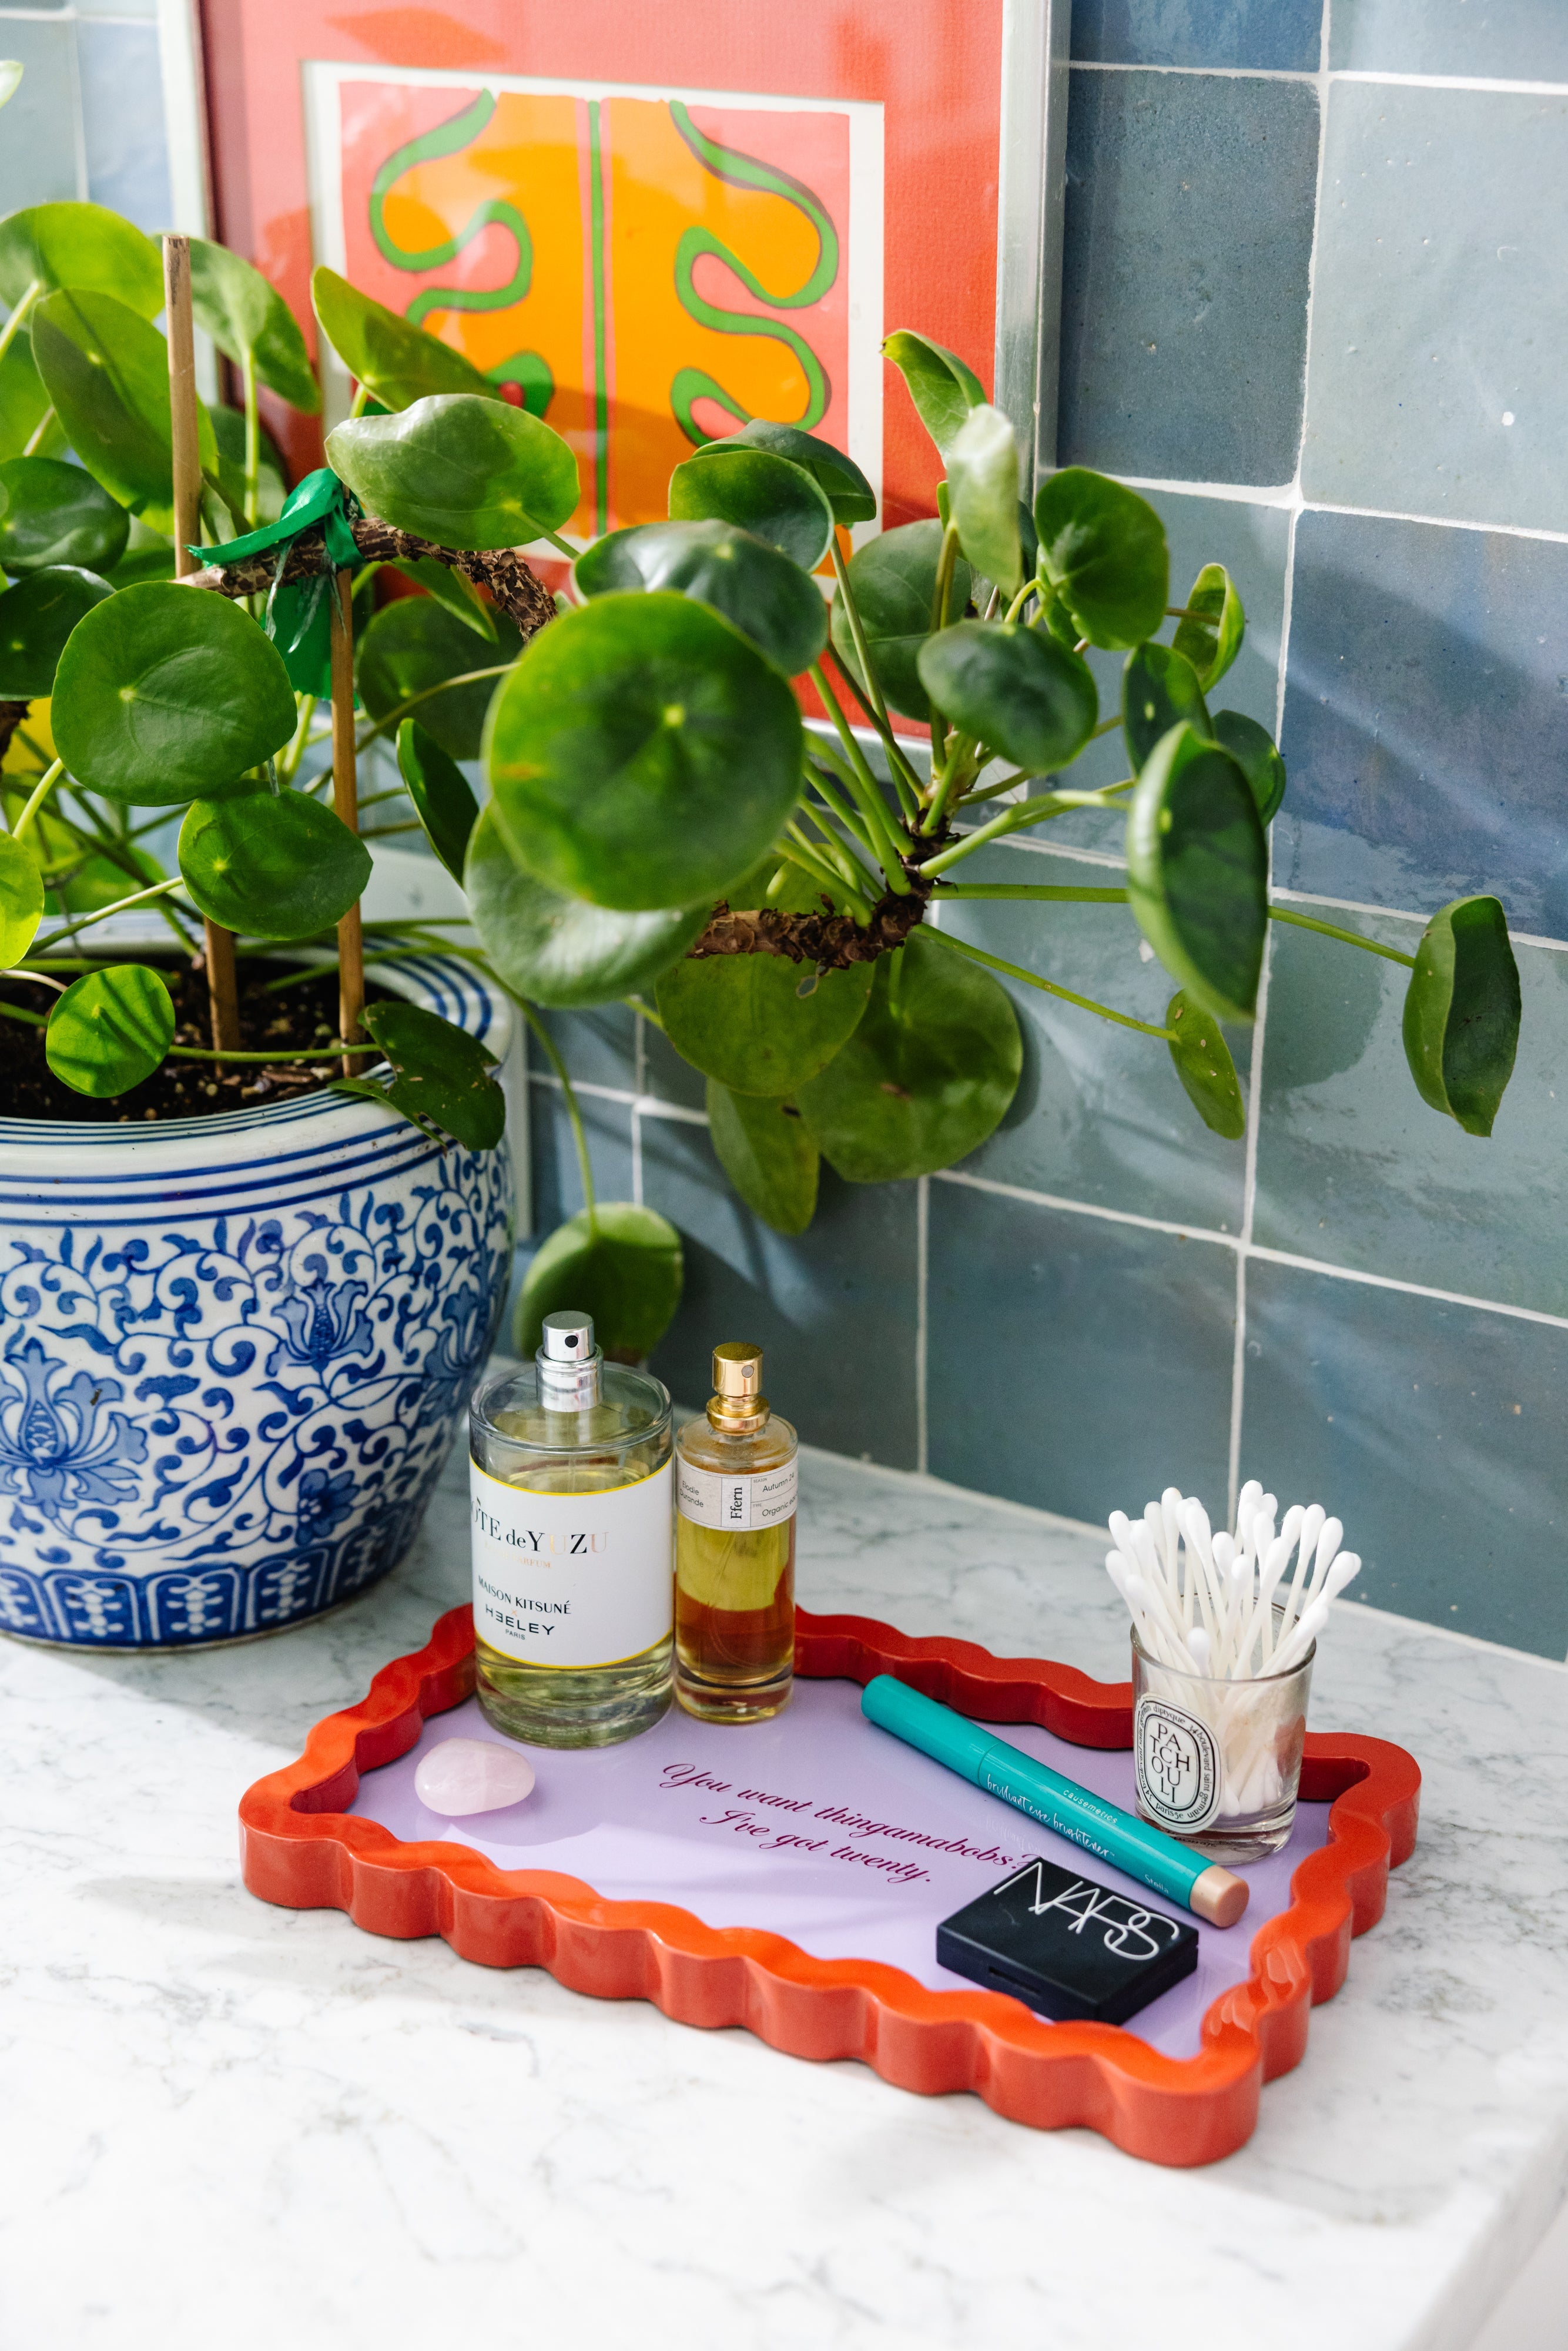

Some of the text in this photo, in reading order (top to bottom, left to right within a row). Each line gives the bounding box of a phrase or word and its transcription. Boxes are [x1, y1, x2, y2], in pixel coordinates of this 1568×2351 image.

[682, 1480, 699, 1495] Elodie
[762, 1478, 788, 1492] Autumn
[679, 1488, 704, 1508] Durande
[730, 1486, 743, 1519] Ffern
[762, 1501, 789, 1516] Organic
[505, 1528, 526, 1548] de
[525, 1530, 609, 1555] YUZU
[512, 1553, 551, 1569] ARFUM
[478, 1575, 572, 1615] MAISON KITSUNÉ
[505, 1629, 525, 1640] PARIS
[1153, 1704, 1186, 1725] diptyque
[659, 1763, 732, 1792] You
[737, 1789, 813, 1812] want
[1203, 1773, 1212, 1791] saint
[1029, 1804, 1051, 1823] eye
[1063, 1789, 1118, 1824] causemetics
[1187, 1791, 1208, 1818] germain
[699, 1810, 931, 1883] I've got twenty.
[1144, 1873, 1170, 1894] Stella
[993, 1861, 1180, 1961] NARS
